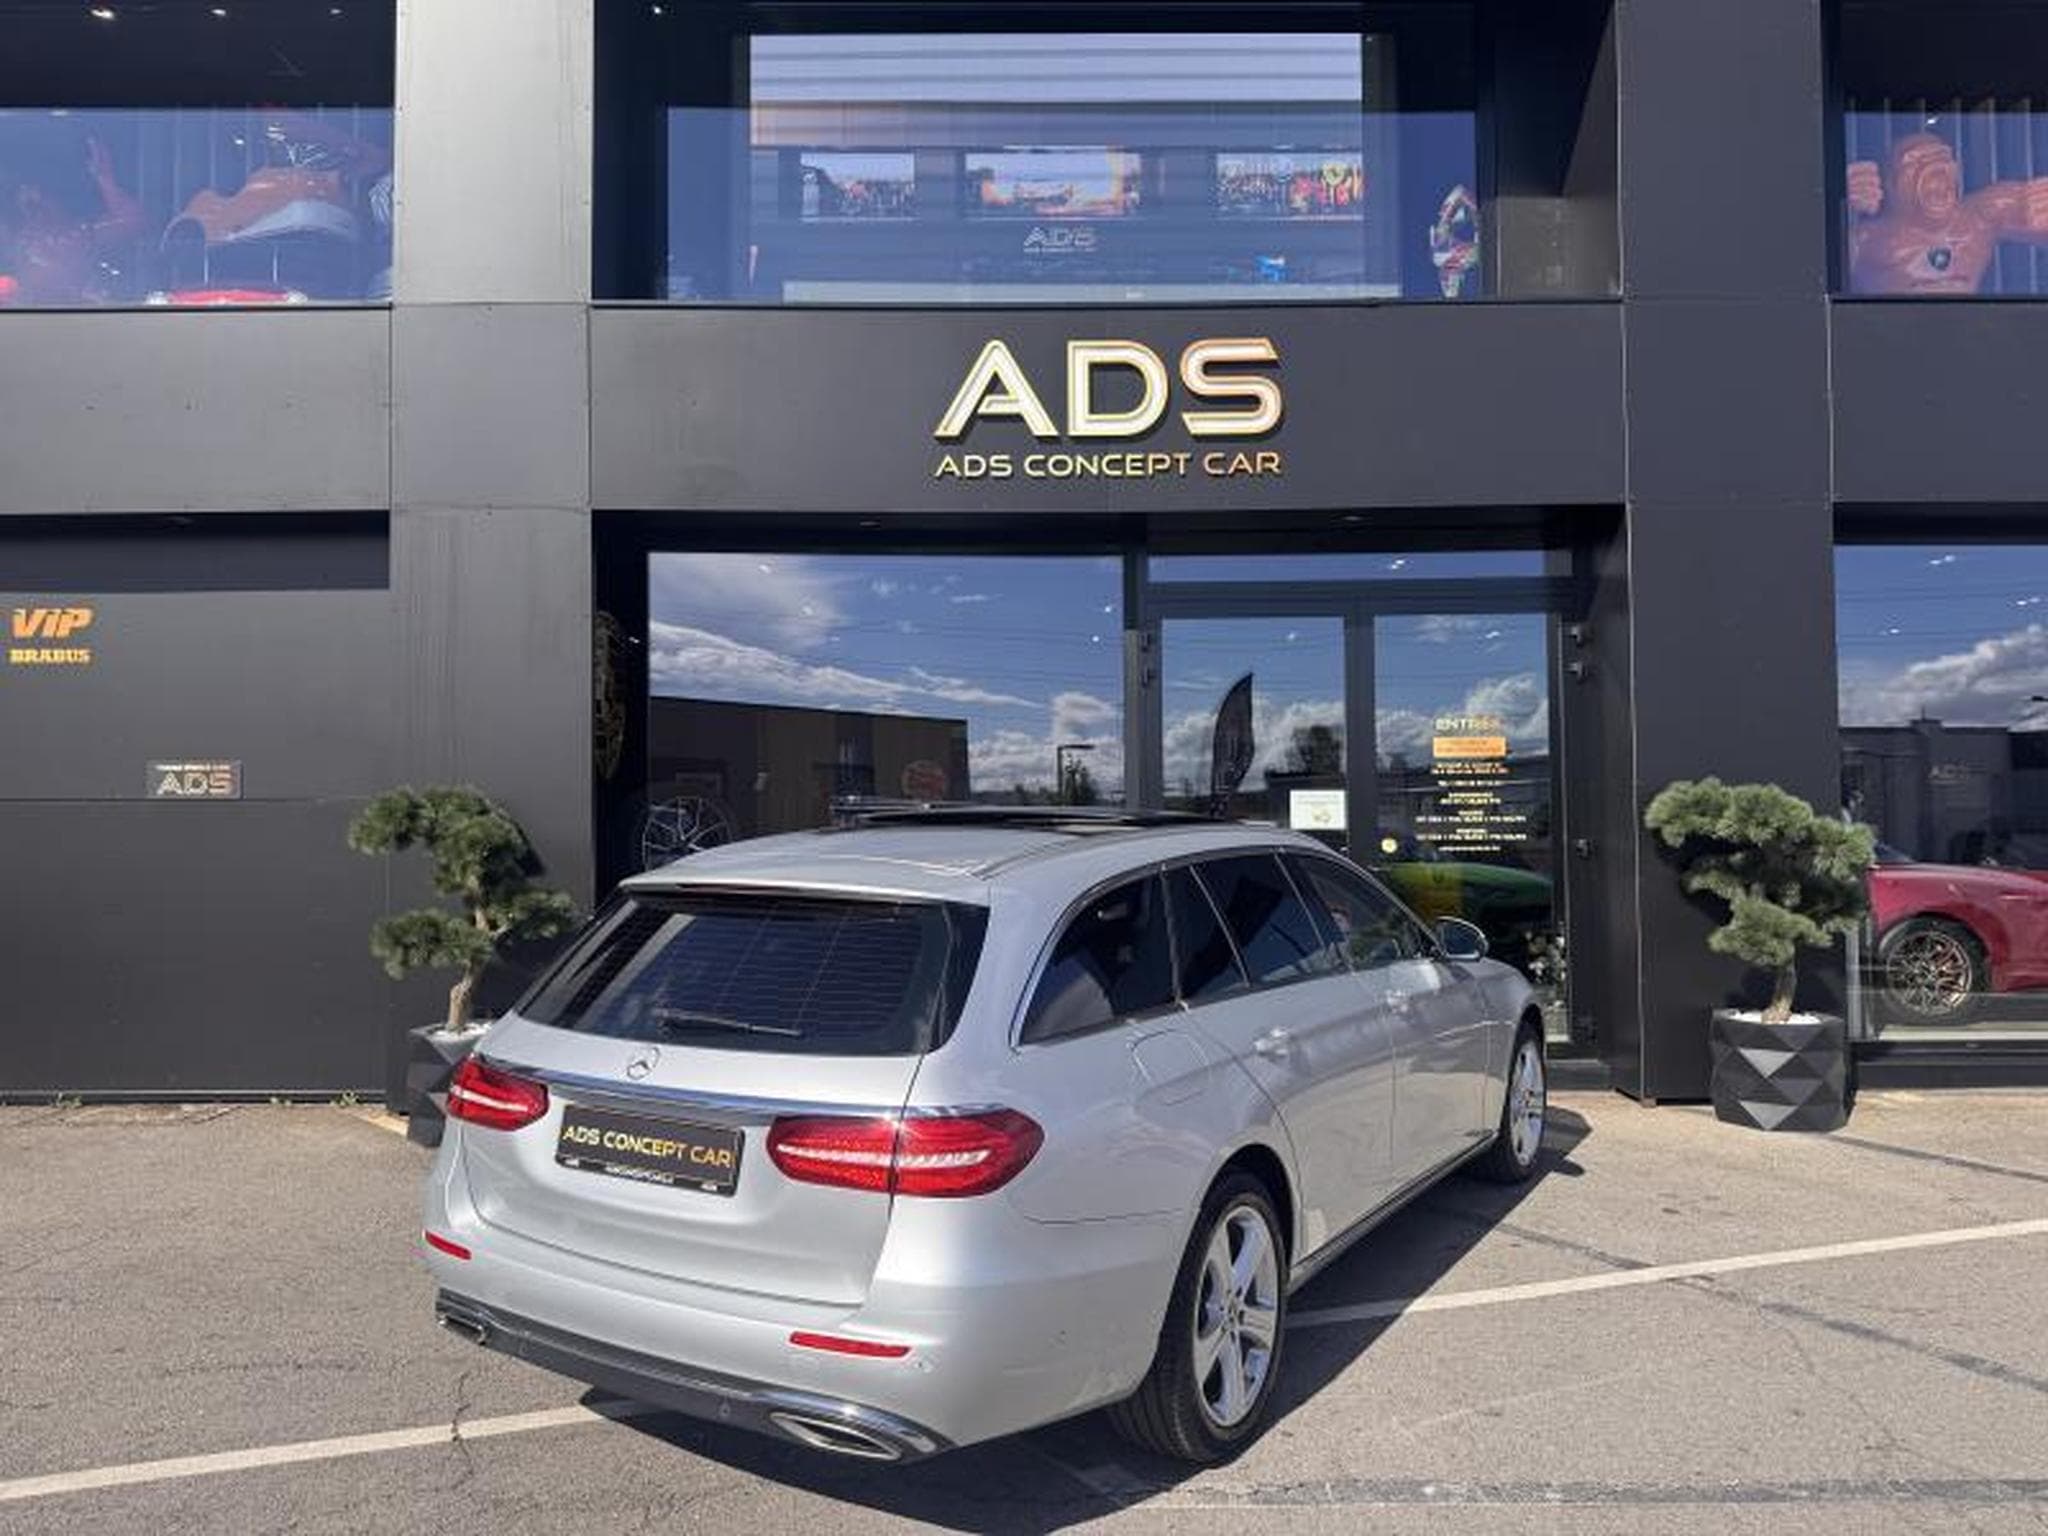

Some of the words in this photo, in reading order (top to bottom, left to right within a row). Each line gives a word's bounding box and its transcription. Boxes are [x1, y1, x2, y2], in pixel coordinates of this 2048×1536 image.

[934, 338, 1284, 437] ADS
[934, 454, 1013, 477] ADS
[1023, 453, 1193, 477] CONCEPT
[1203, 451, 1282, 475] CAR
[10, 649, 92, 664] BRABUS
[156, 772, 233, 796] ADS
[562, 1125, 601, 1145] ADS
[602, 1130, 689, 1160] CONCEPT
[690, 1145, 732, 1168] CAR
